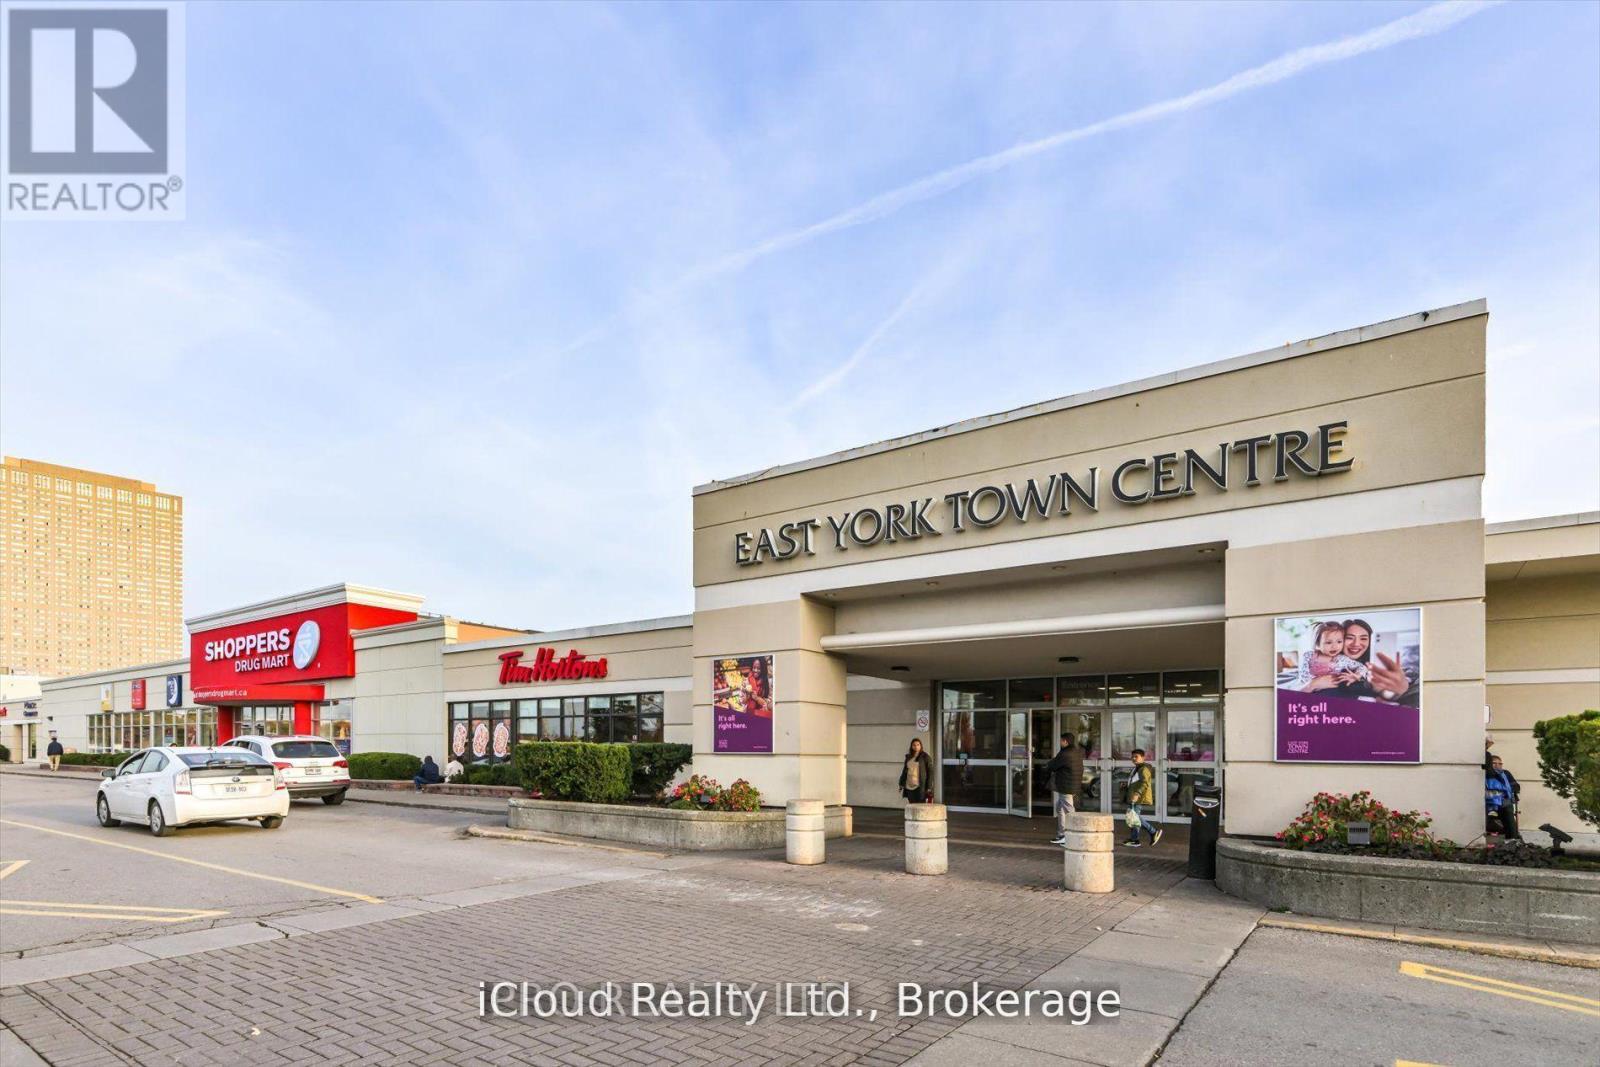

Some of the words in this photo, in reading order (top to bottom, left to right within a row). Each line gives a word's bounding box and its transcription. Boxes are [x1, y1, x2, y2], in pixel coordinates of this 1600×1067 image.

[734, 518, 821, 566] EAST
[827, 497, 942, 550] YORK
[943, 466, 1098, 531] TOWN
[1110, 420, 1356, 504] CENTRE
[204, 628, 290, 662] SHOPPERS
[234, 656, 261, 673] DRUG
[262, 654, 290, 669] MART
[498, 651, 533, 685] Tim
[532, 647, 608, 682] Hortons
[1288, 703, 1307, 713] It's
[1311, 702, 1327, 713] all
[1288, 714, 1319, 727] right
[1322, 714, 1356, 725] here.
